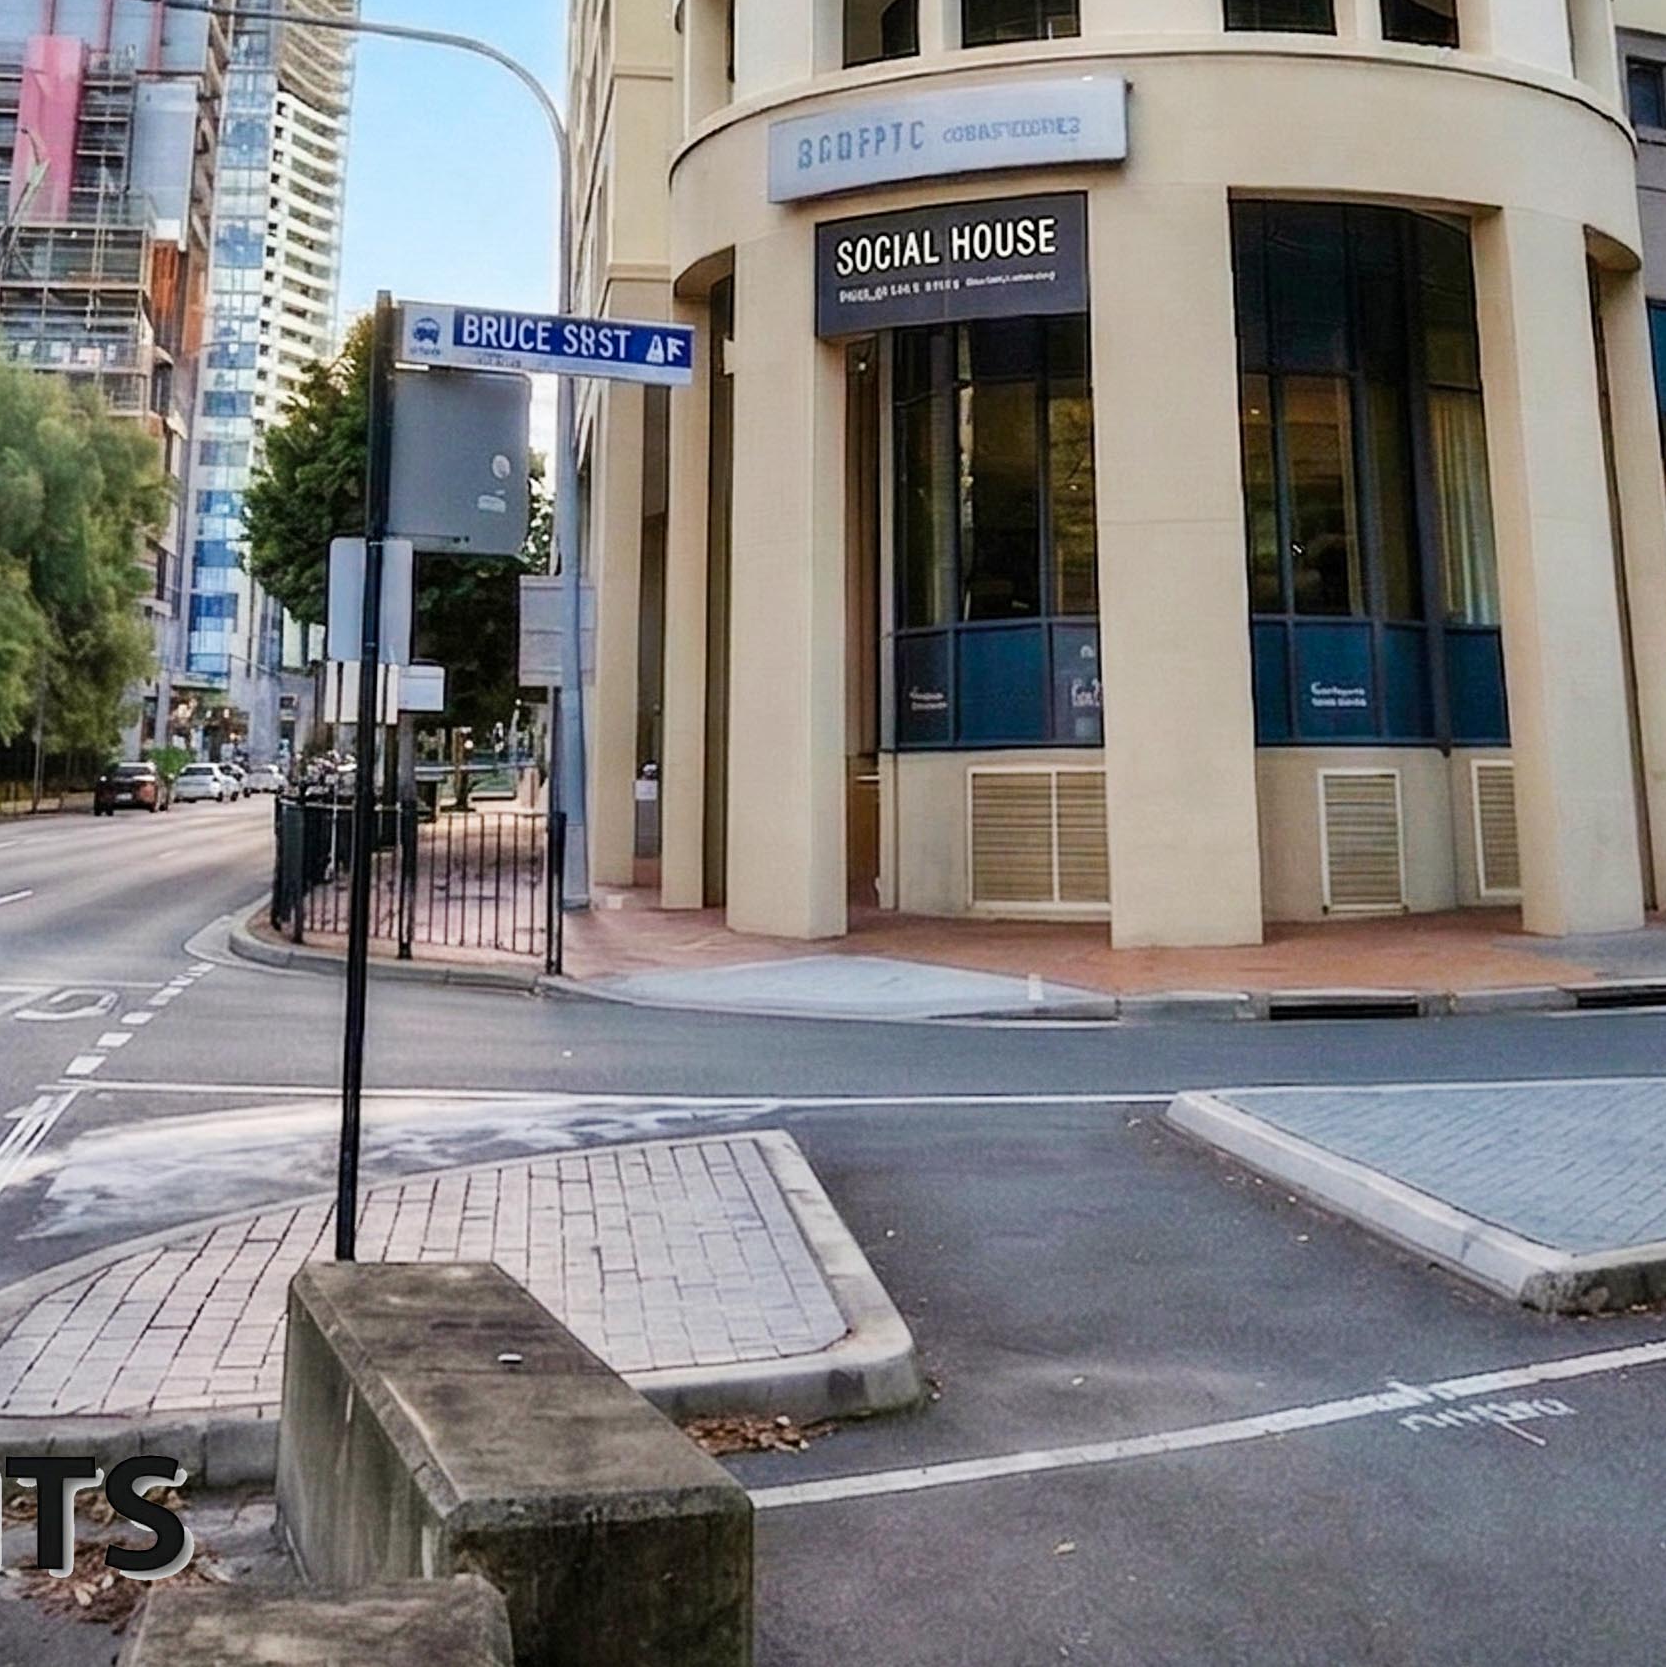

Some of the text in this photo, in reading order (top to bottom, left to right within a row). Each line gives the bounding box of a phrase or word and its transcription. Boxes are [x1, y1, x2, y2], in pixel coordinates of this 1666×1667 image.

[836, 218, 1057, 275] SOCIAL HOUSE
[462, 314, 552, 352] BRUCE
